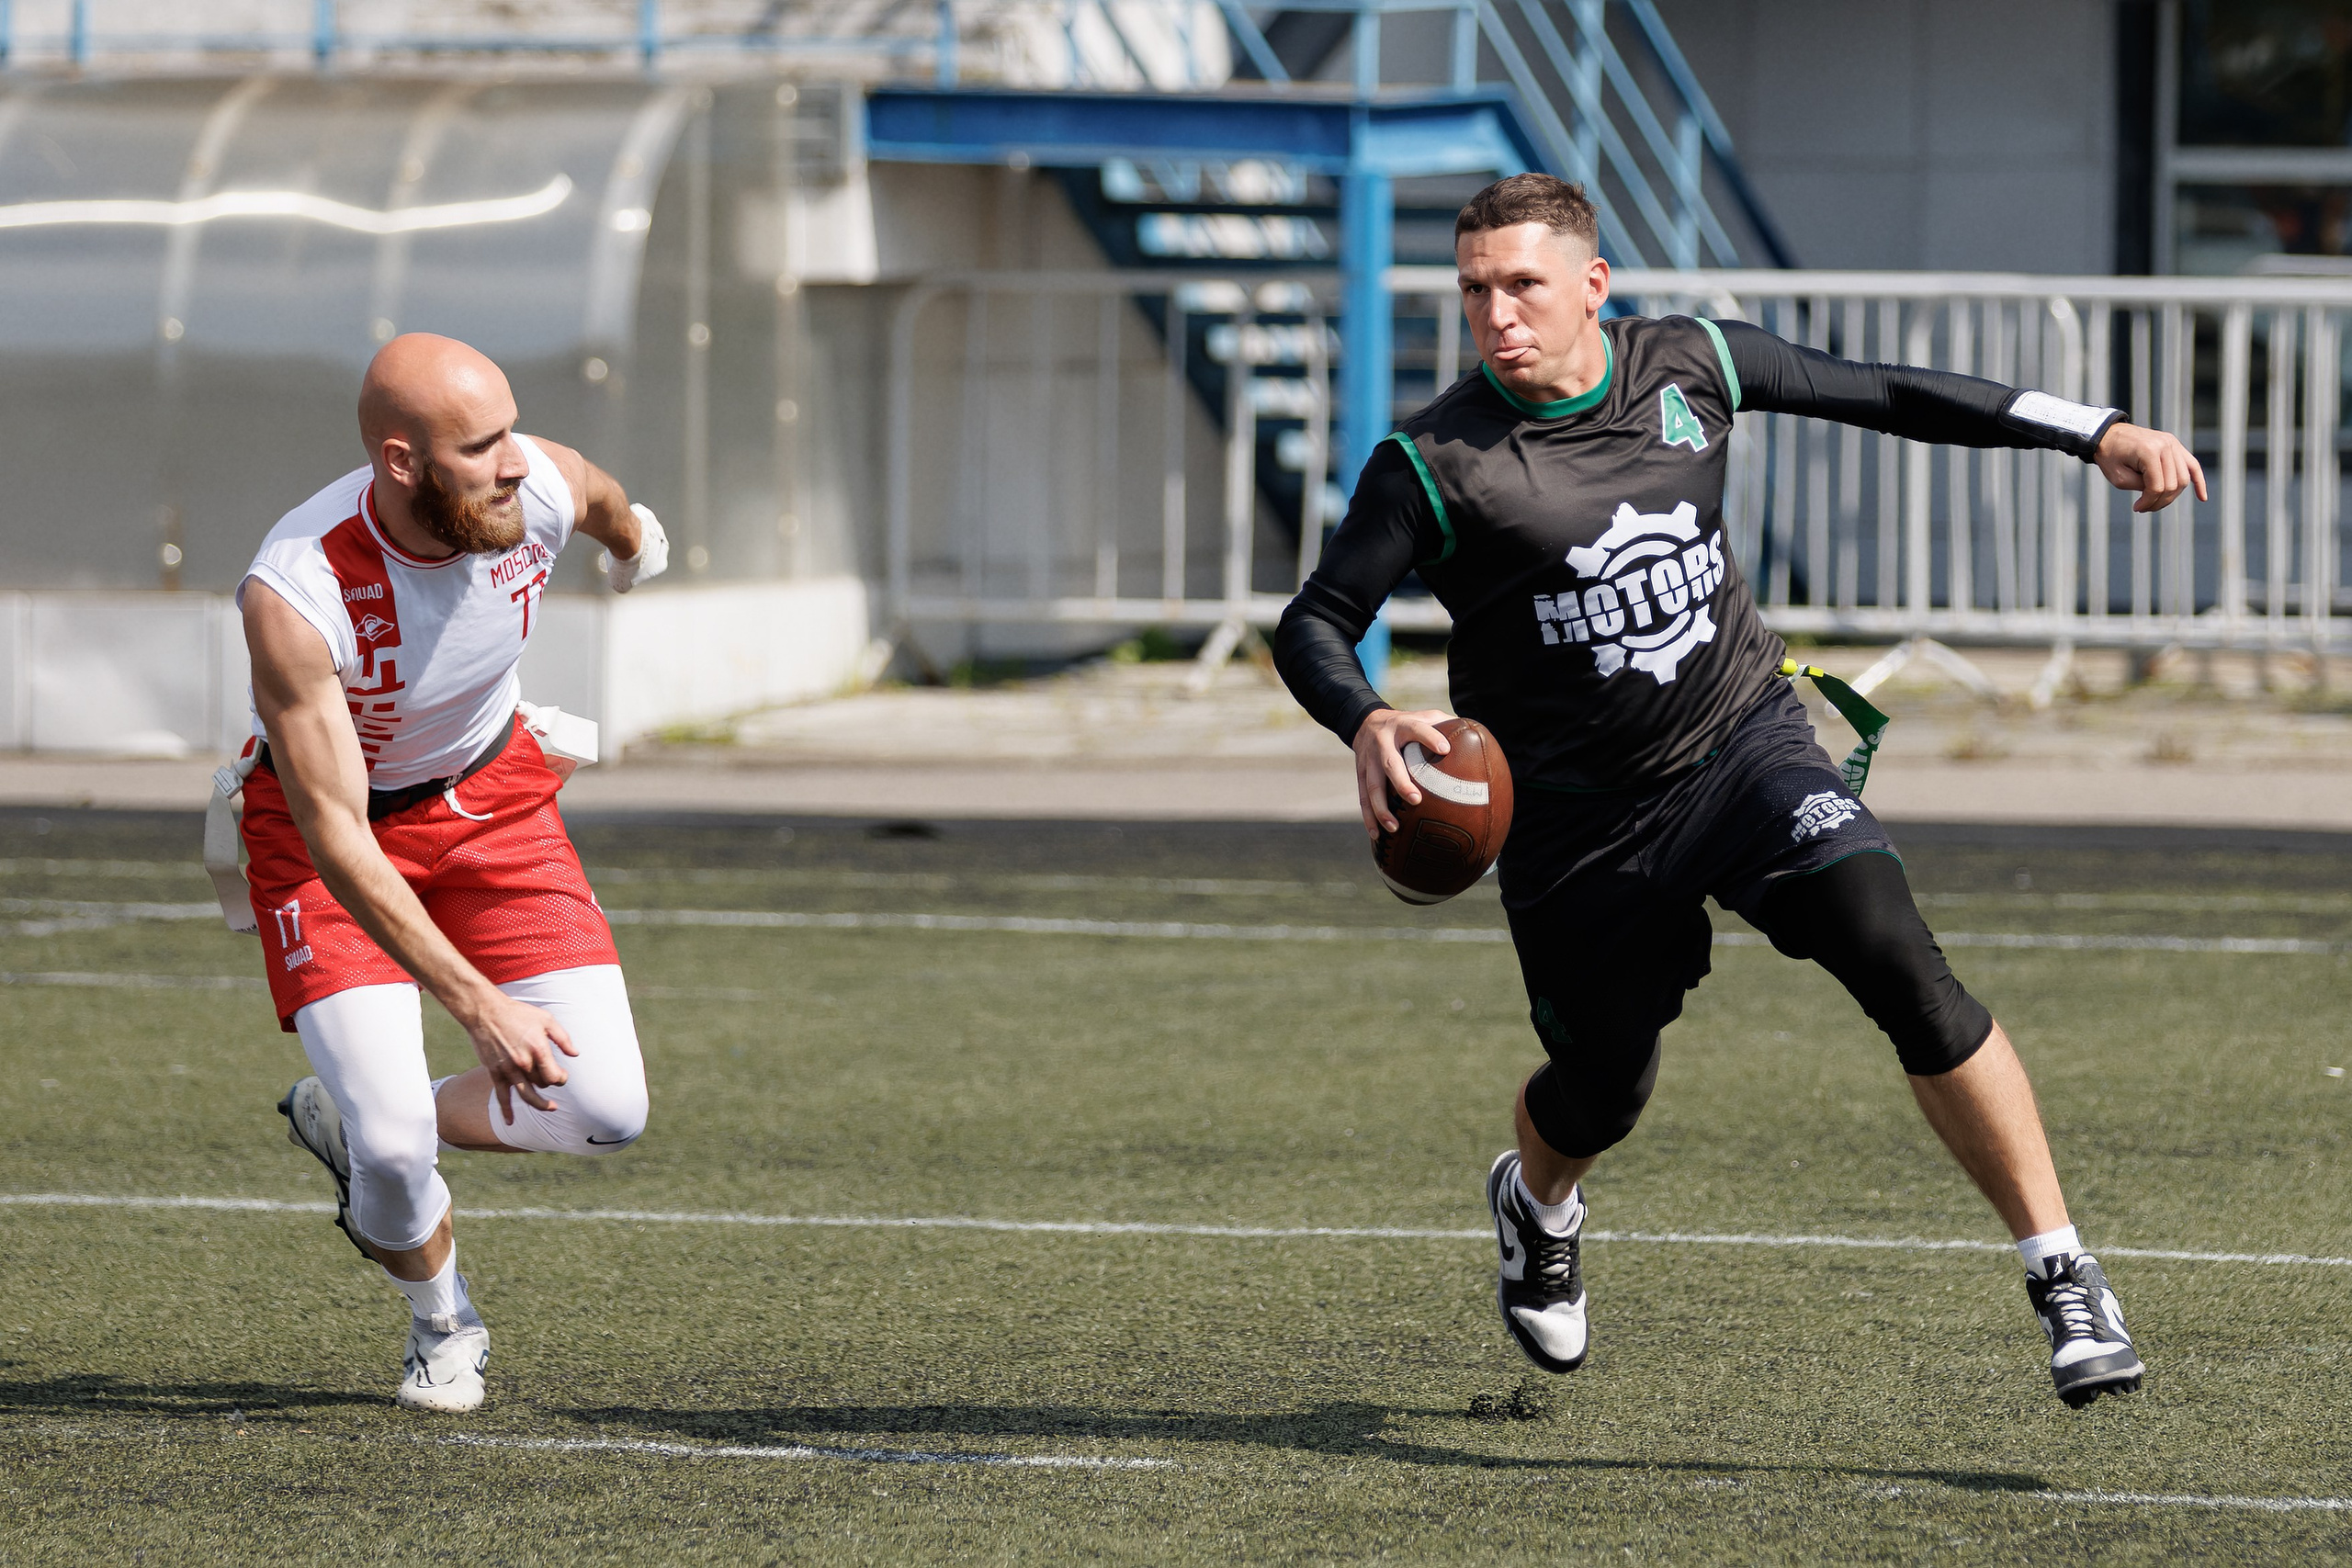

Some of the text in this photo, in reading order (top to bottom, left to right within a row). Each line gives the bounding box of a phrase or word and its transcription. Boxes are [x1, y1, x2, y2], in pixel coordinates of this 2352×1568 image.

[1659, 382, 1709, 452] 4
[344, 582, 384, 603] SQUAD
[1533, 529, 1725, 645] MOTORS
[1791, 797, 1861, 843] MOTORS
[285, 944, 313, 972] SQUAD
